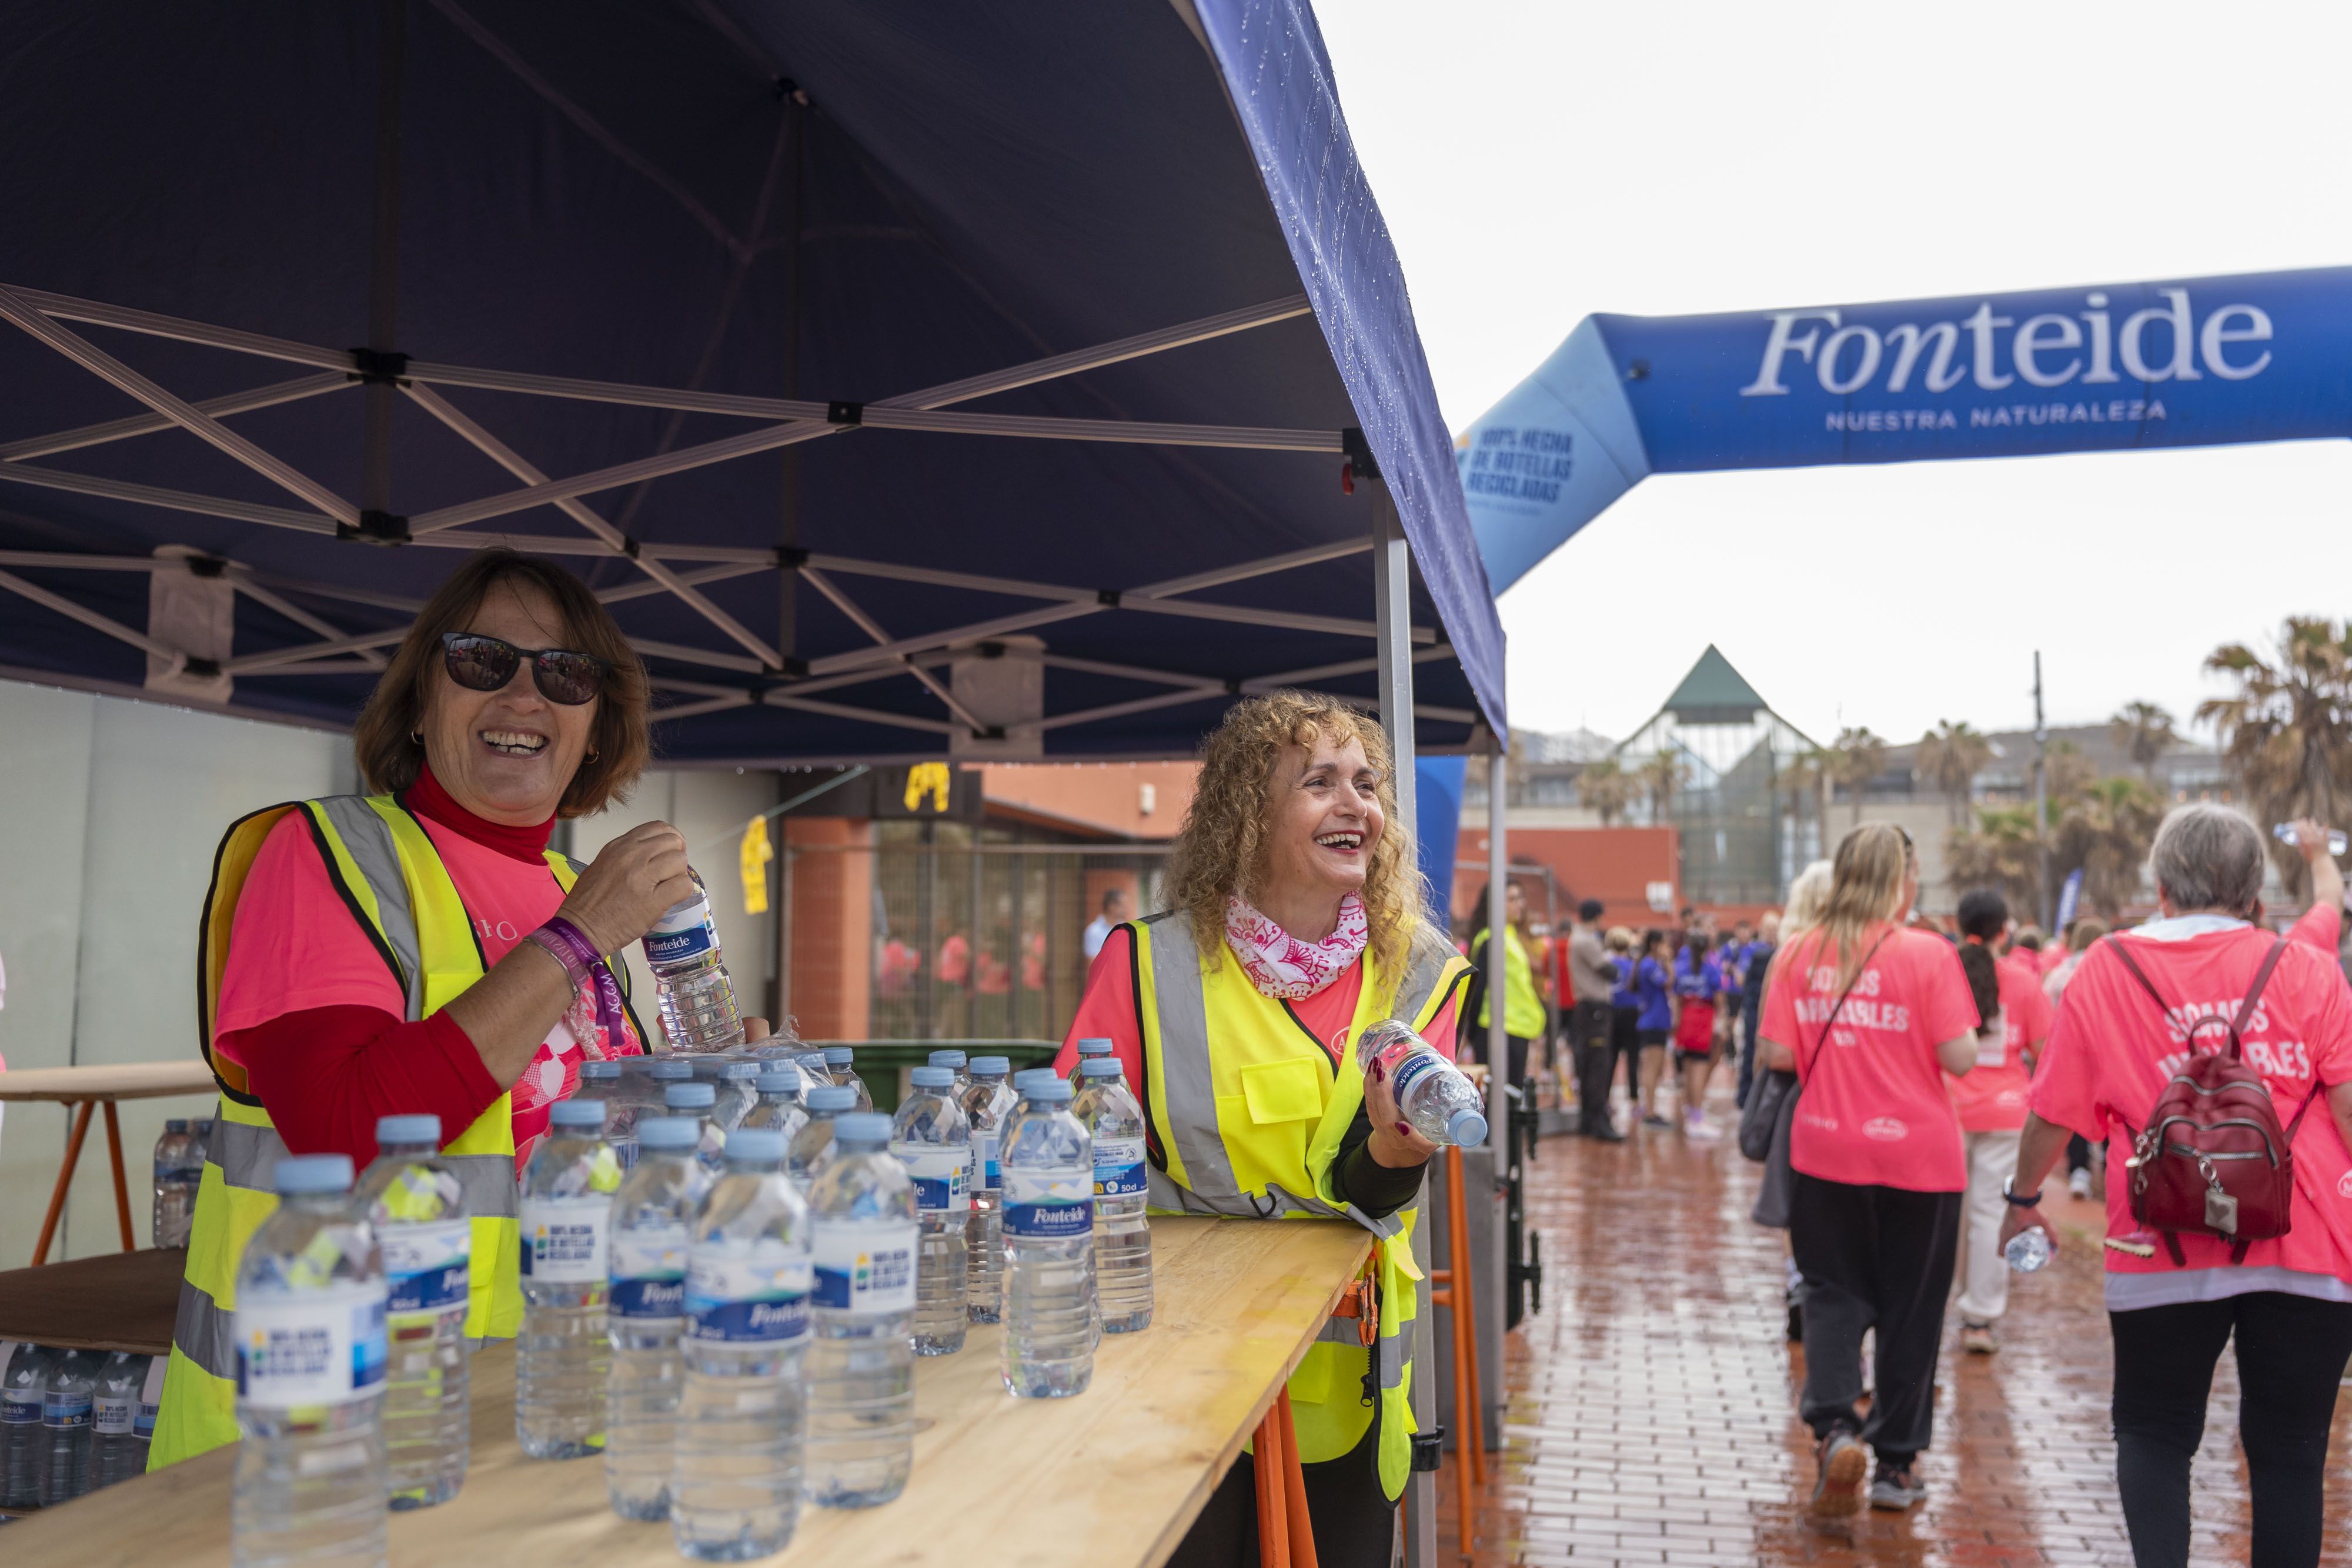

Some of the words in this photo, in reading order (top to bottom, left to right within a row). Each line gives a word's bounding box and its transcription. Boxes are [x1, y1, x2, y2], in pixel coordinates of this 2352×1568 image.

[1739, 287, 2274, 396] Fonteide
[1826, 409, 1957, 432] NUESTRA
[1970, 400, 2168, 429] NATURALEZA
[649, 937, 690, 951] Fonteide
[1399, 1058, 1433, 1087] Fonteide
[1033, 1206, 1087, 1224] Fonteide
